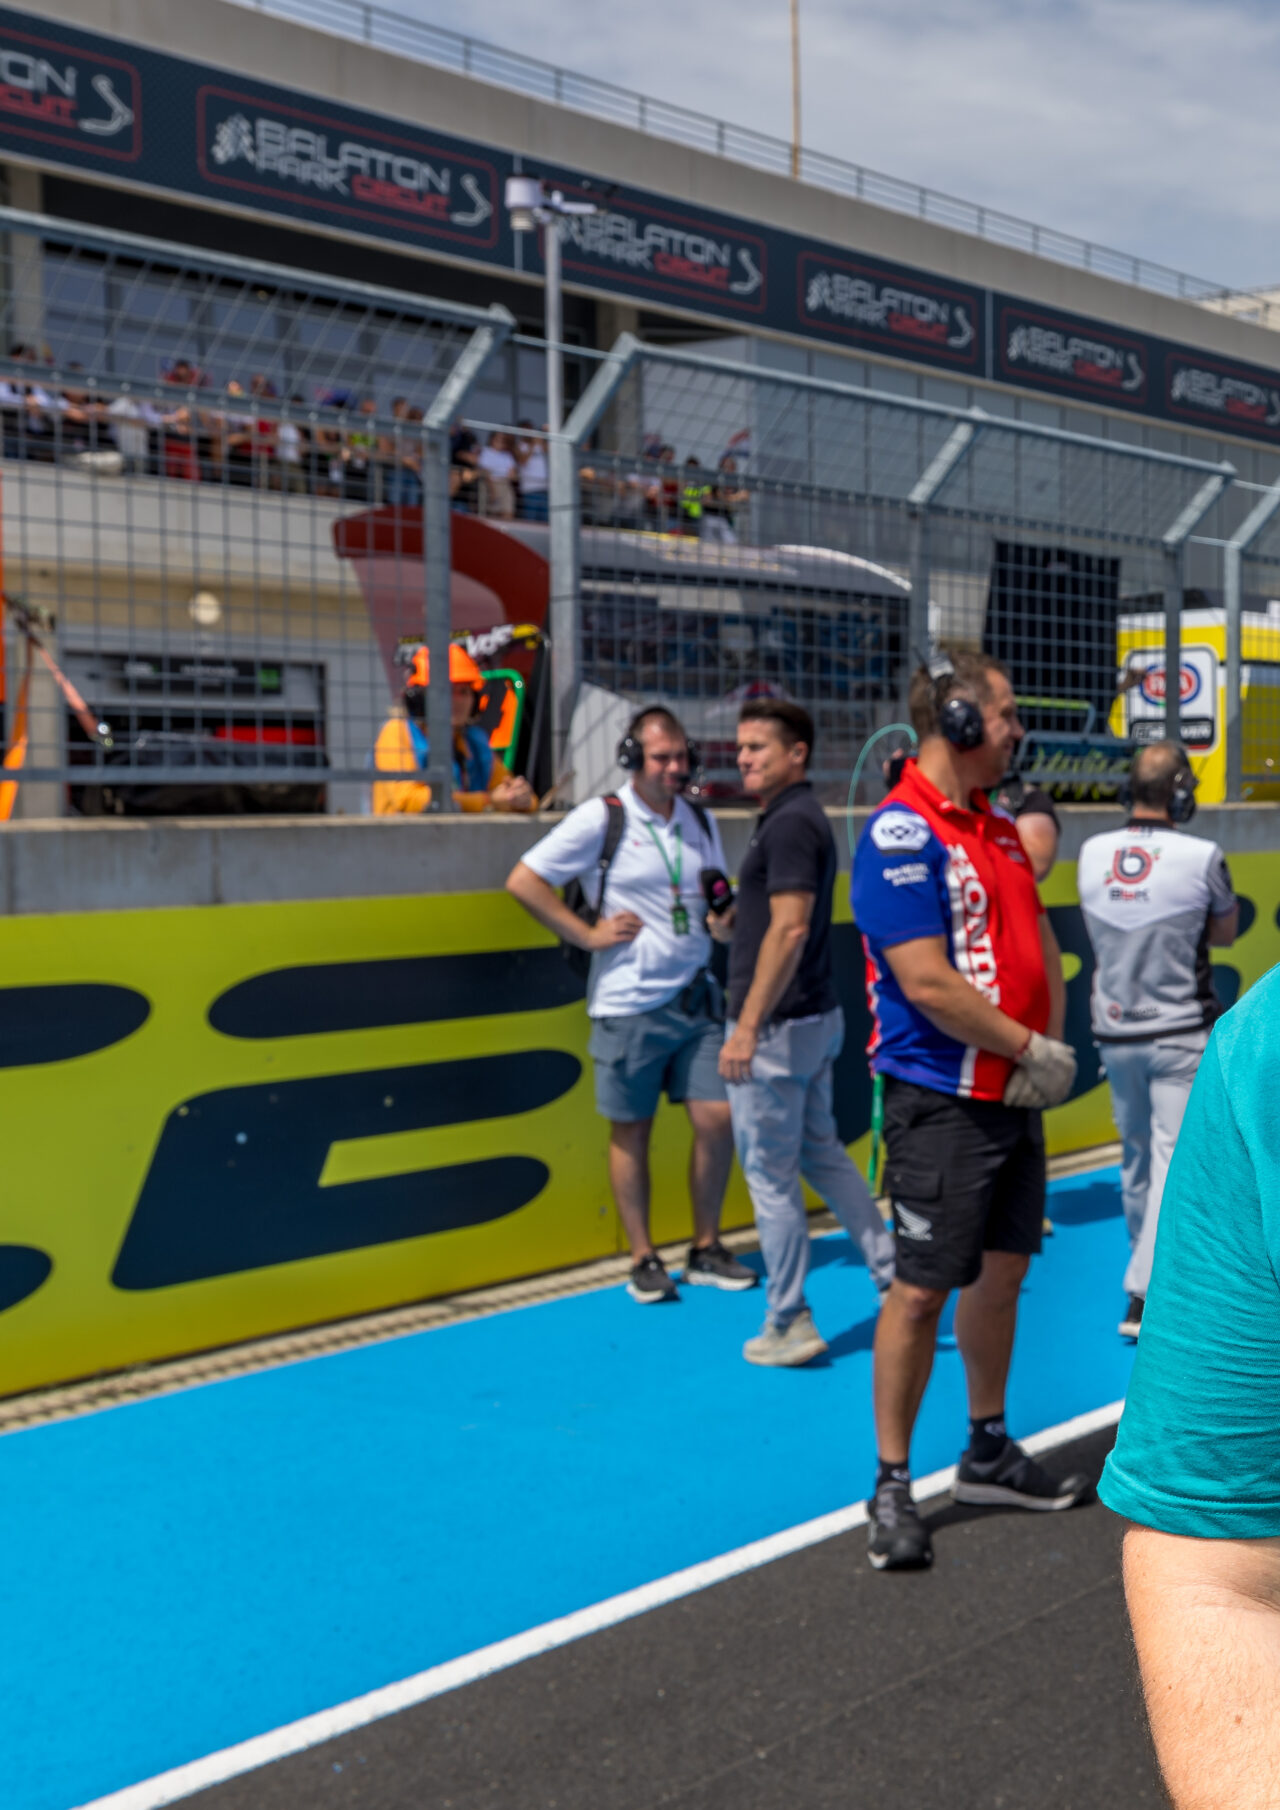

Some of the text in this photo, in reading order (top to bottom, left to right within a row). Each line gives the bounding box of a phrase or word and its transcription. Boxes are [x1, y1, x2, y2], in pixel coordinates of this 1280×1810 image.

[254, 117, 450, 194] BALATON
[254, 152, 350, 197] PARK
[581, 214, 732, 268] BALATON
